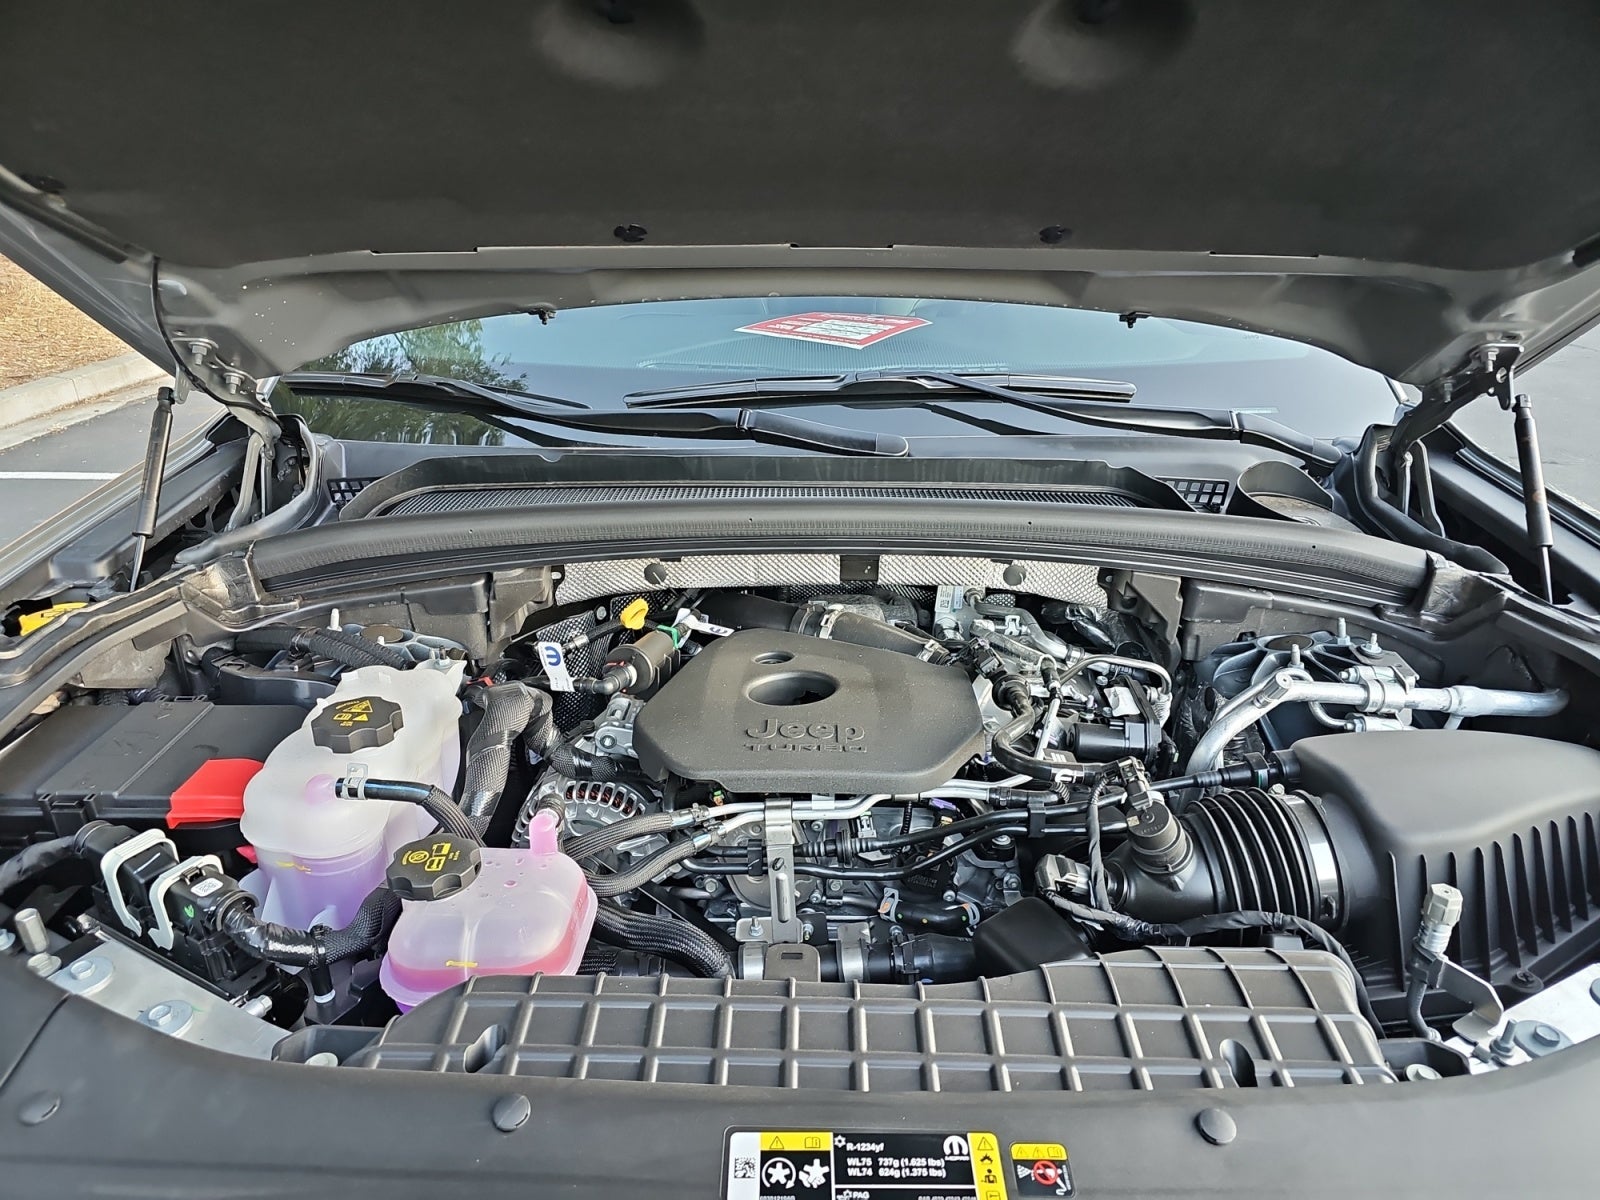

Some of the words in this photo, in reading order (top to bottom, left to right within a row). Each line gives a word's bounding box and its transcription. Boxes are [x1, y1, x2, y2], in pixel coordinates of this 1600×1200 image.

[746, 718, 865, 743] Jeep
[744, 743, 867, 753] TURBO
[846, 1142, 884, 1153] R-1234yf
[847, 1157, 872, 1166] WL75
[878, 1157, 900, 1168] 737g
[901, 1158, 927, 1168] (1.625
[928, 1158, 945, 1168] lbs)
[847, 1167, 873, 1177] WL74
[878, 1168, 900, 1178] 624g
[902, 1168, 928, 1178] (1.375
[929, 1168, 946, 1178] lbs)
[852, 1191, 870, 1199] PAG
